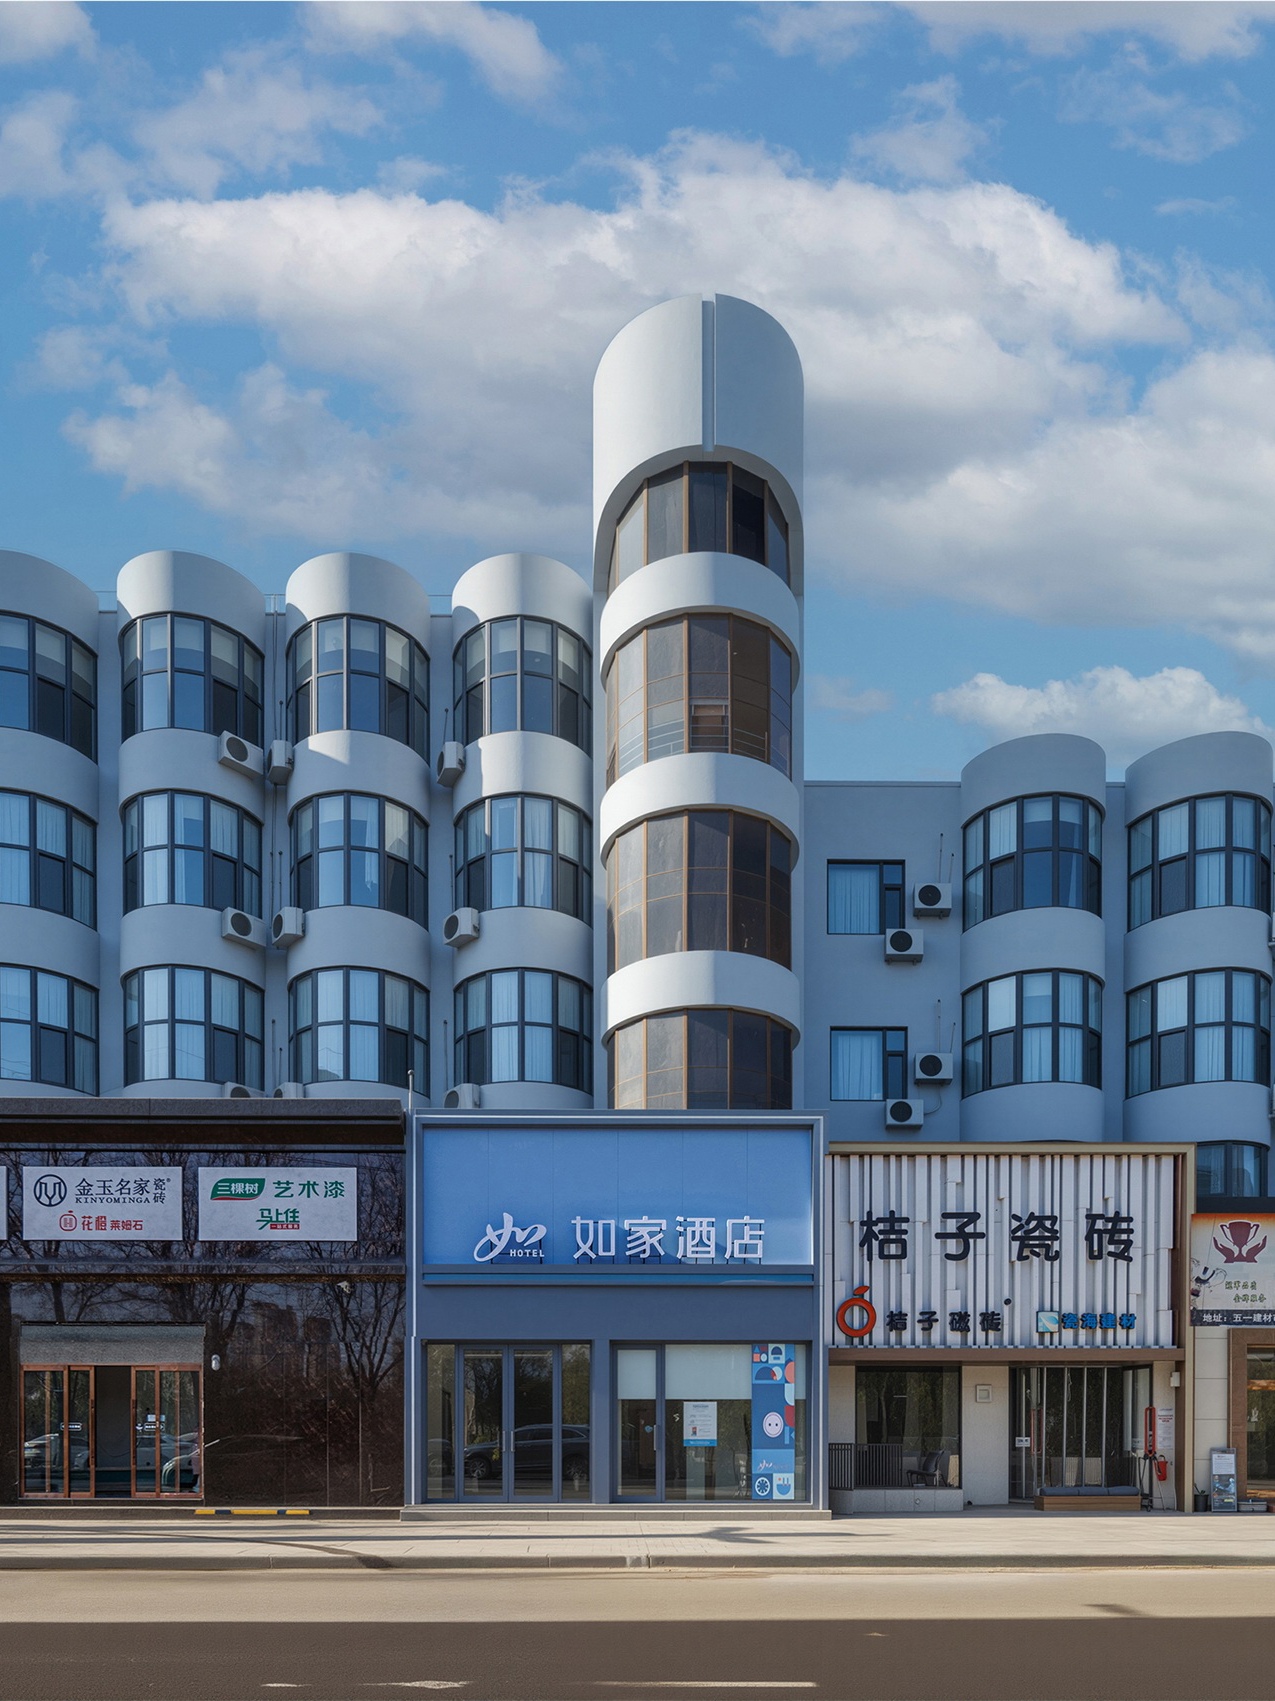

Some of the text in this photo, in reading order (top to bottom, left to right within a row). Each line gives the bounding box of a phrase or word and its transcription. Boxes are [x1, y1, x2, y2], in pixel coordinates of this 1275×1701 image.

[75, 1178, 150, 1196] 金玉名家
[153, 1178, 166, 1204] 瓷砖
[217, 1182, 259, 1194] 三棵树
[272, 1180, 345, 1199] 艺术漆
[110, 1220, 143, 1231] 莱姆石
[256, 1208, 300, 1230] 马上住
[571, 1215, 765, 1260] 如家酒店
[859, 1210, 1134, 1262] 桔子瓷砖
[510, 1249, 545, 1257] HOTEL
[886, 1310, 1001, 1332] 桔子磁砖
[1062, 1312, 1136, 1329] 瓷海建材
